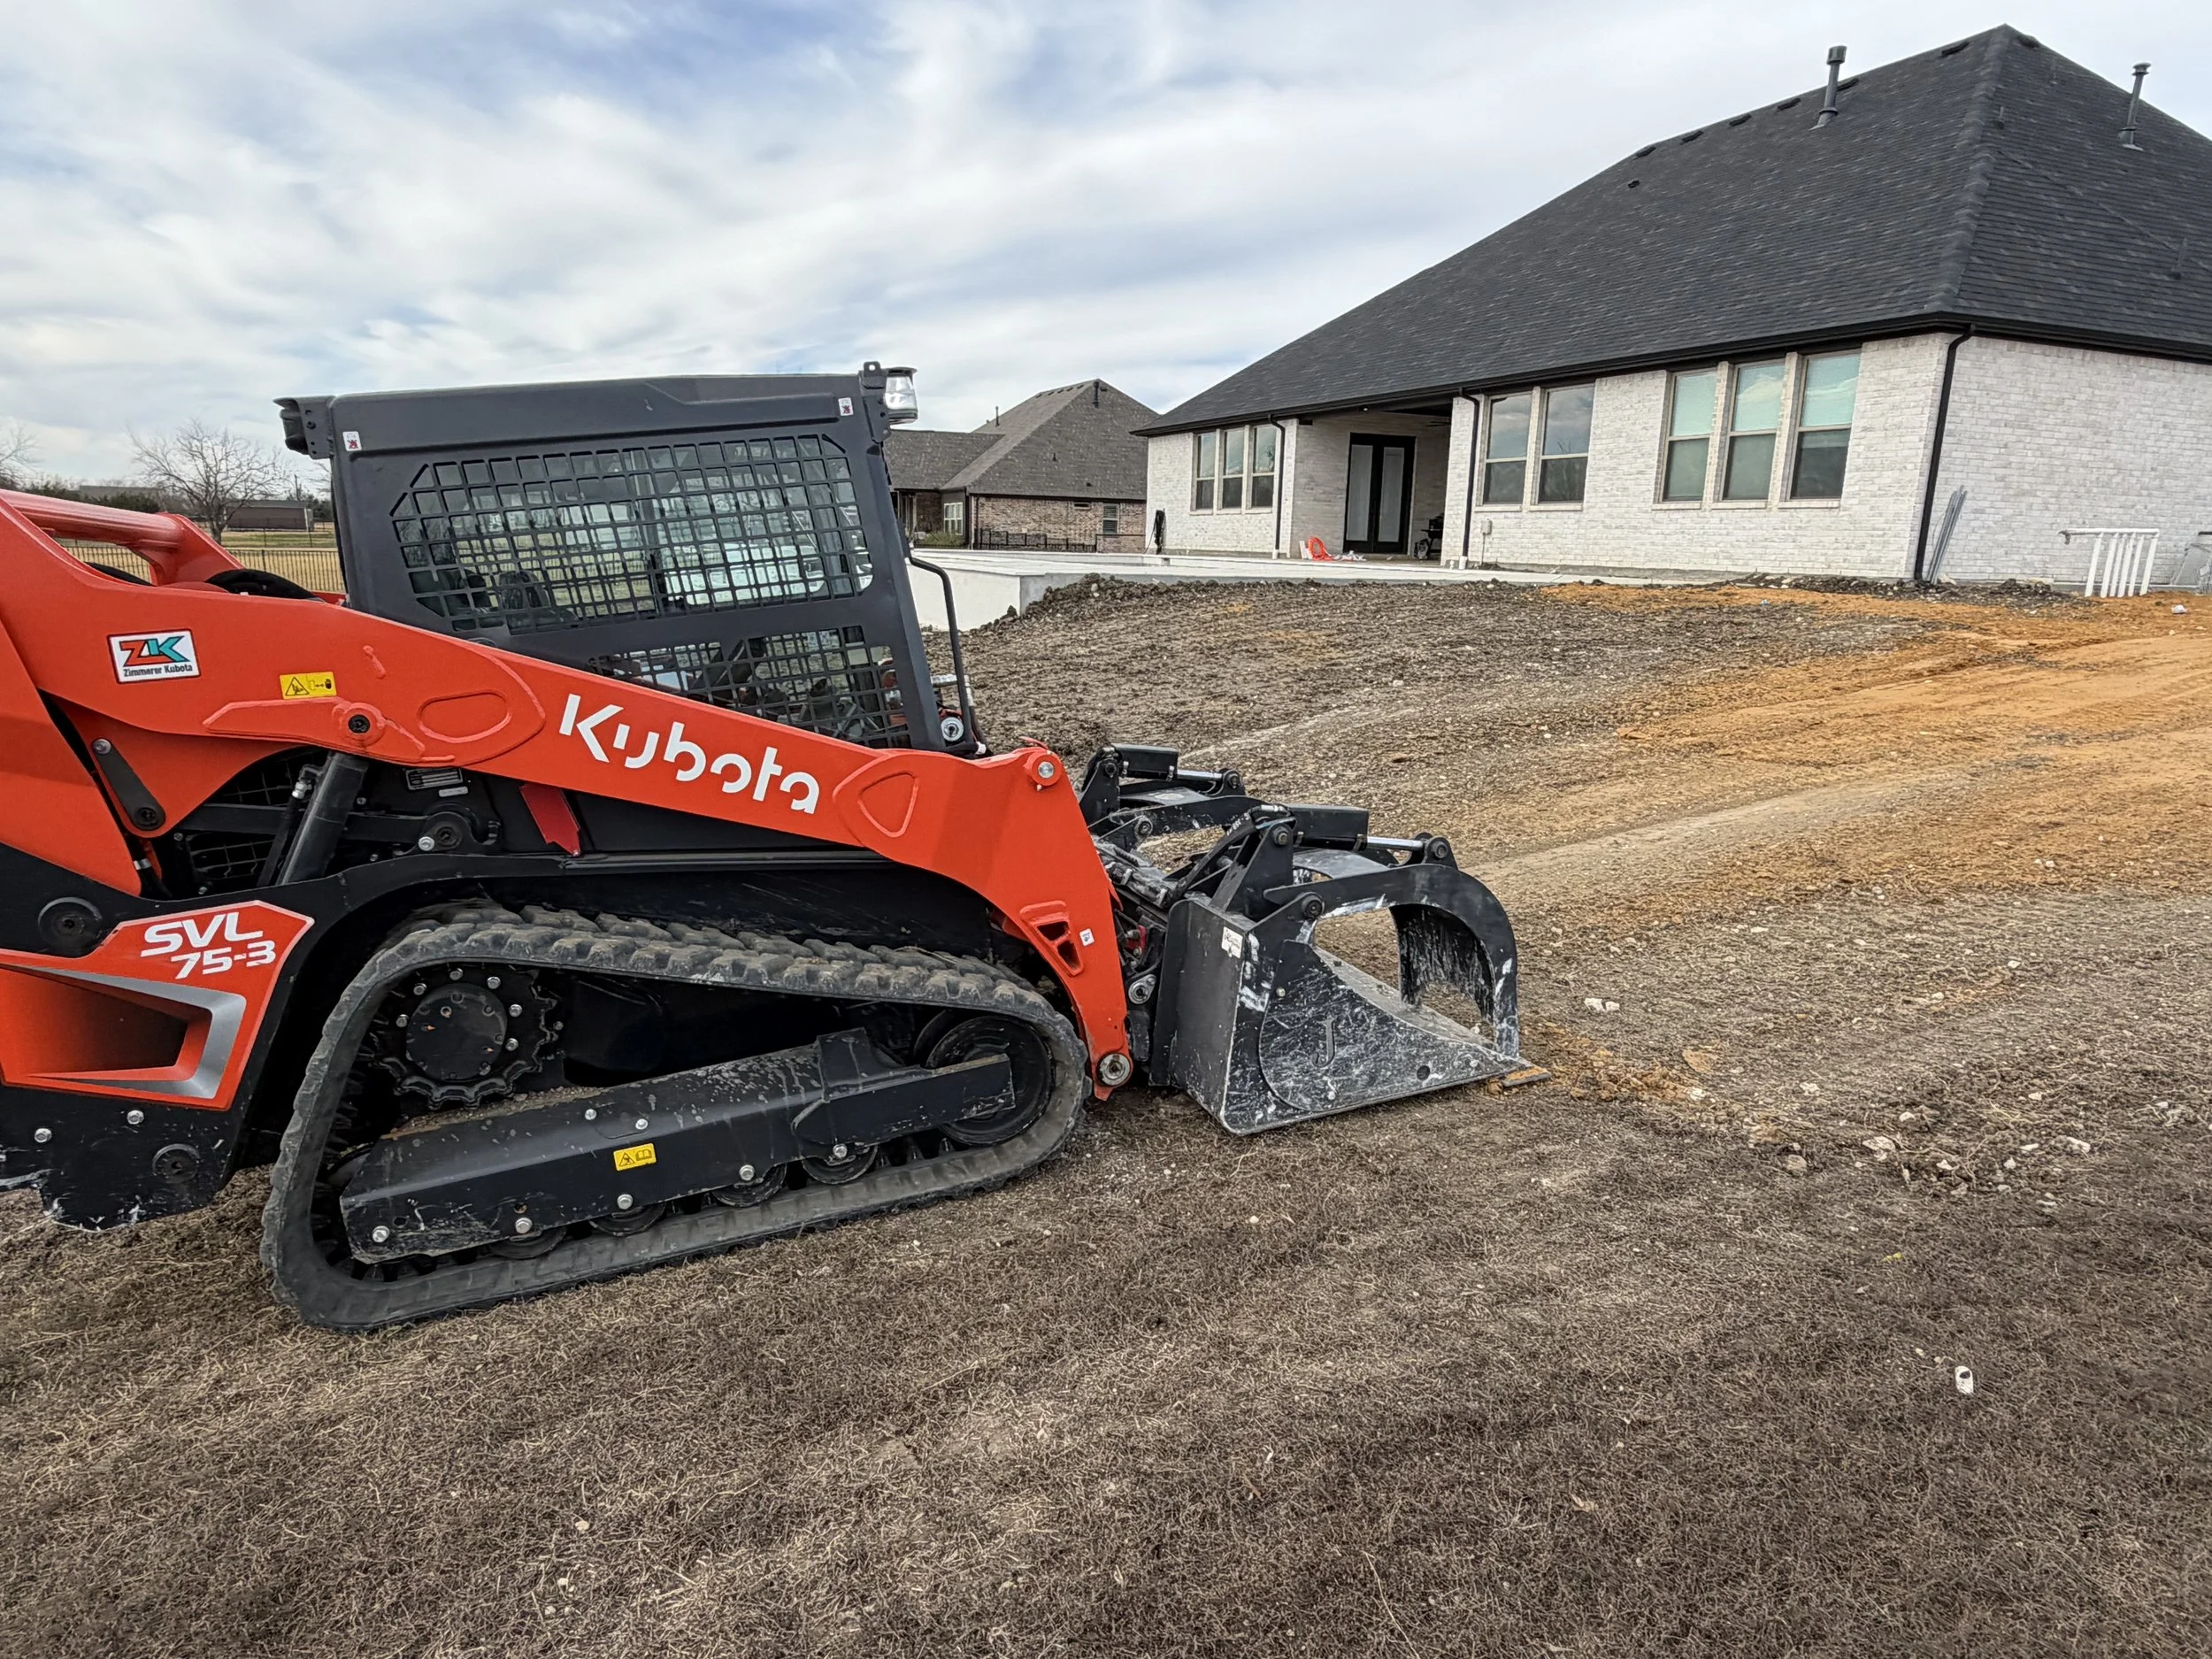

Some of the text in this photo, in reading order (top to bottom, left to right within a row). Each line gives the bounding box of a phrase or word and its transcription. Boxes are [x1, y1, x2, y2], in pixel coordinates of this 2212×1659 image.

[119, 635, 190, 667] ZK
[123, 664, 193, 678] Zimmerer Kubota
[559, 693, 820, 814] Kubota
[140, 911, 264, 957] SVL
[171, 940, 276, 979] 75-3
